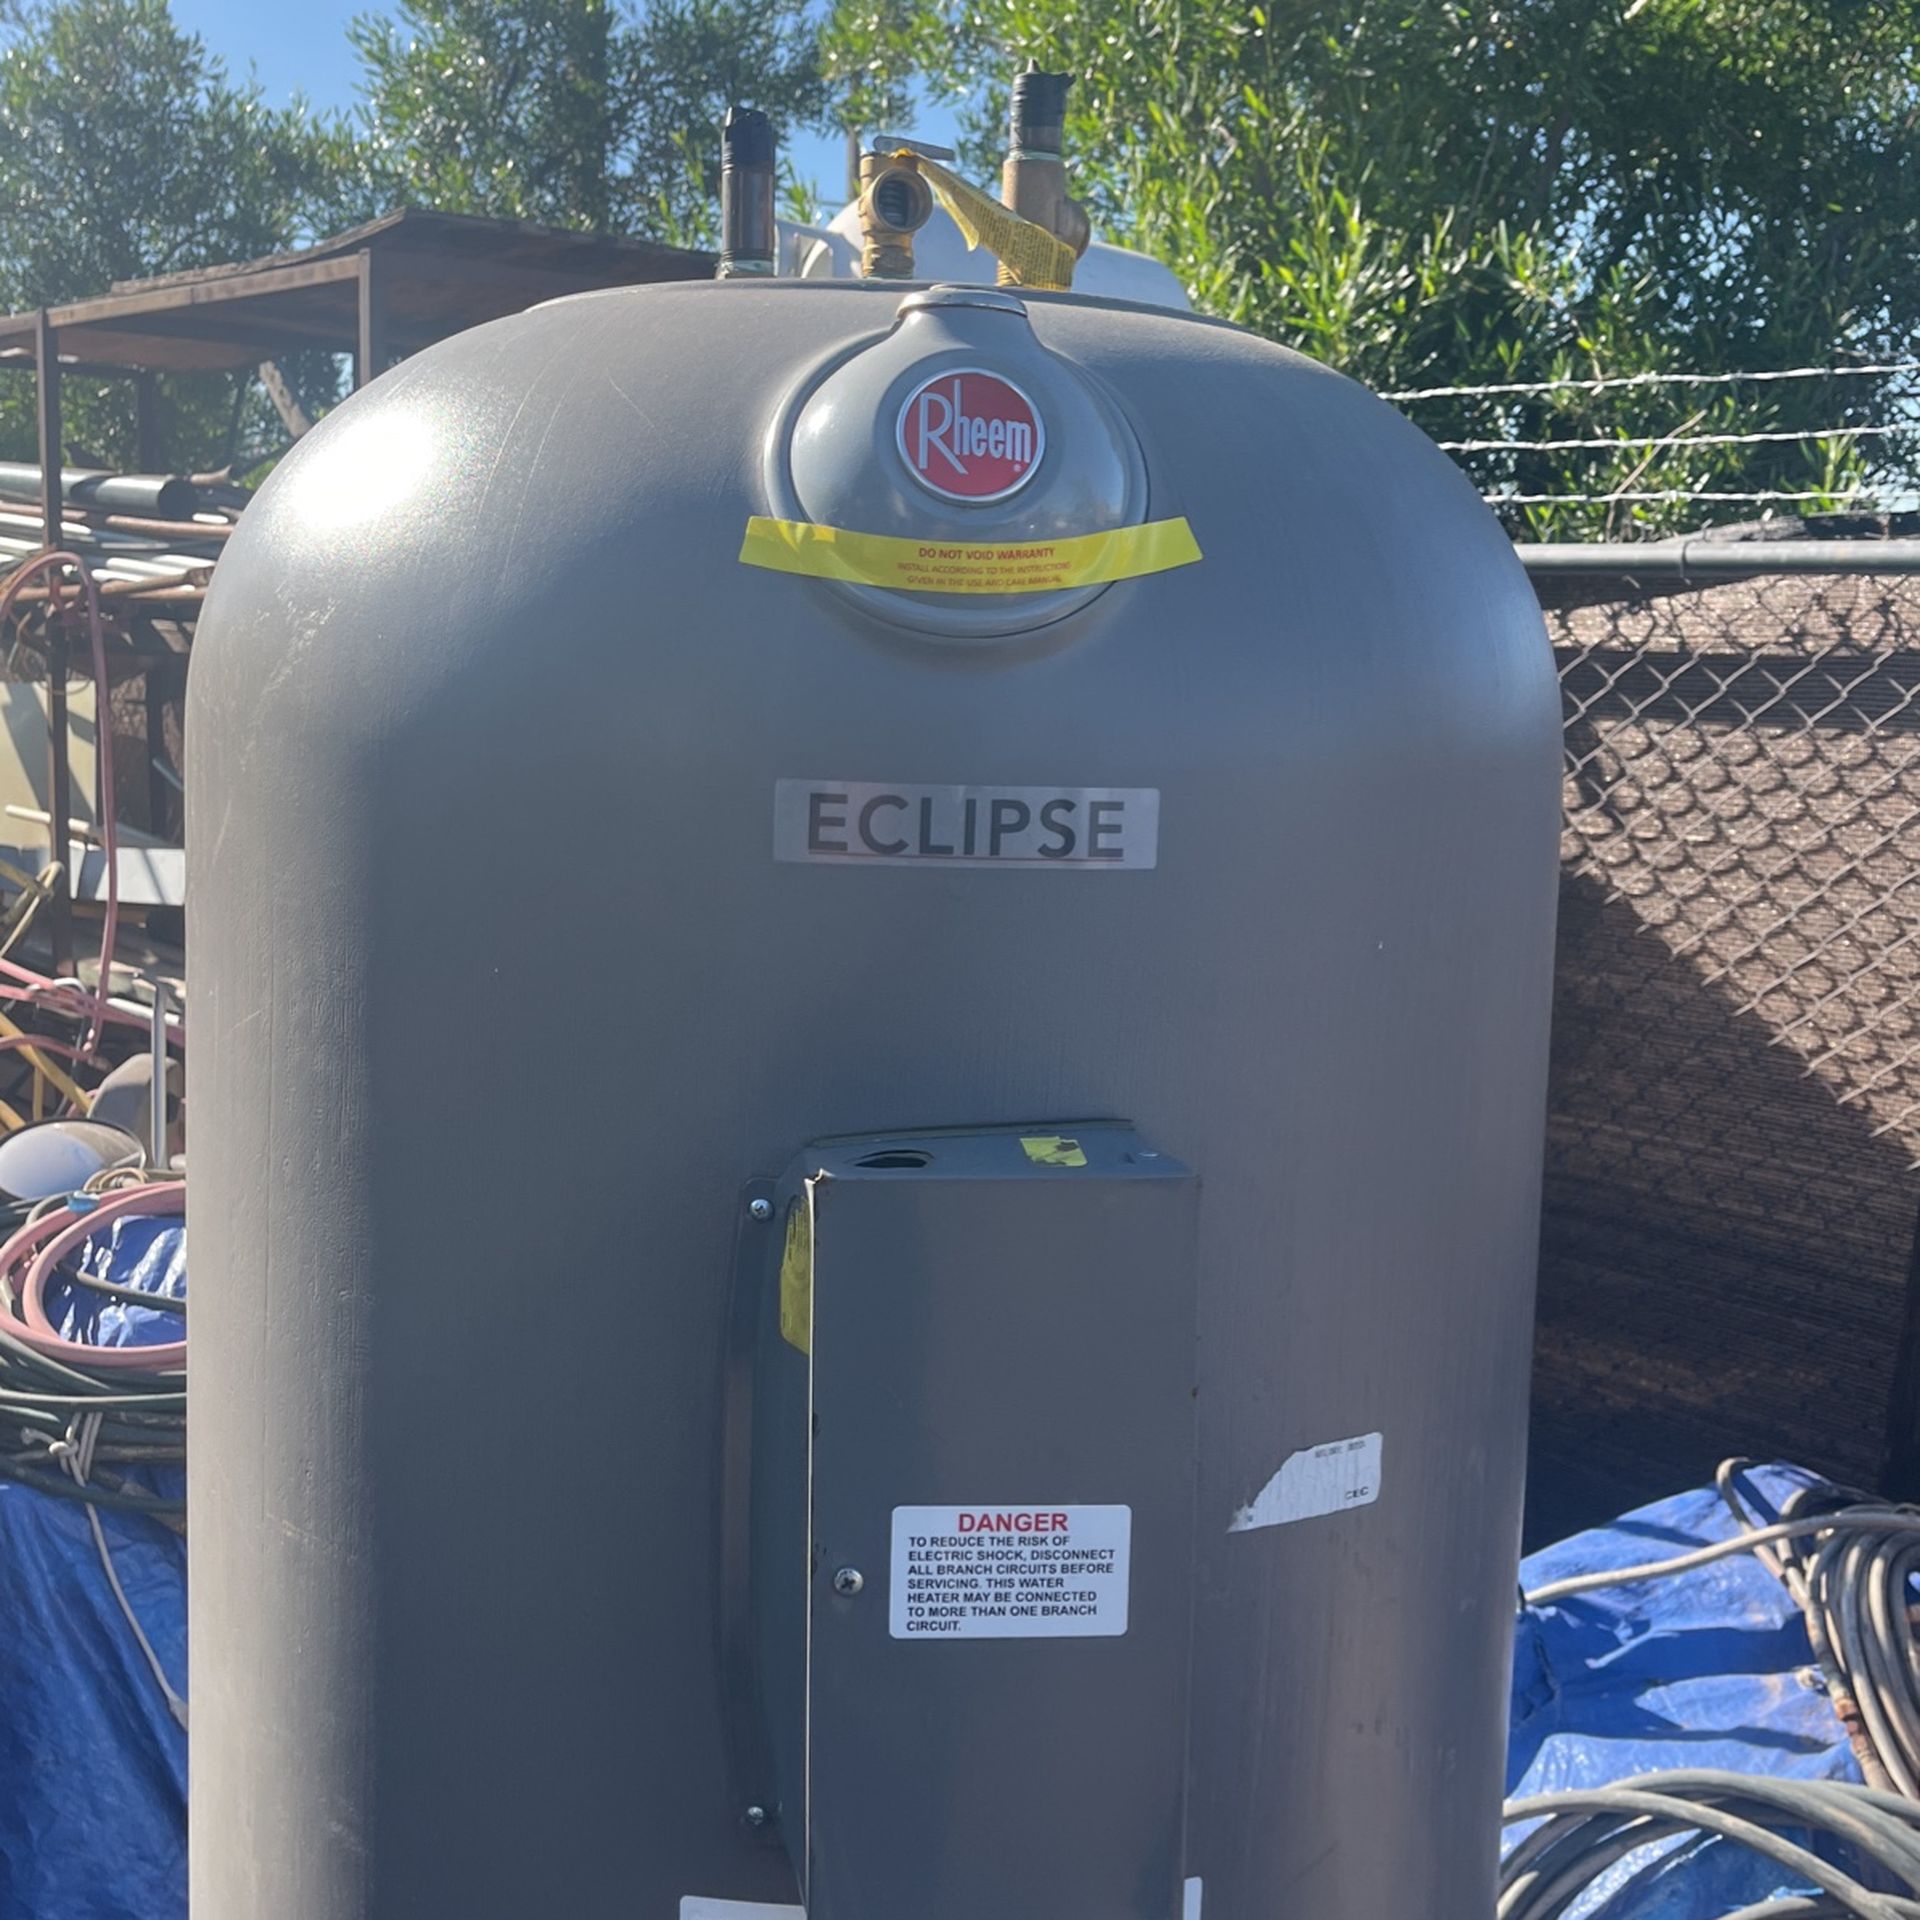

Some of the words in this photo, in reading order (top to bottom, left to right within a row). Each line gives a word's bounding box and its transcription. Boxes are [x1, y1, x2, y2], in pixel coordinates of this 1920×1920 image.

[918, 379, 1031, 475] Rheem
[919, 548, 936, 558] DO
[939, 549, 963, 559] NOT
[967, 550, 993, 560] VOID
[997, 547, 1055, 560] WARRANTY
[898, 562, 928, 572] INSTALL
[932, 565, 983, 574] ACCORDING
[1000, 566, 1015, 574] THE
[908, 576, 934, 585] GIVEN
[949, 578, 964, 586] THE
[967, 579, 984, 587] USE
[986, 578, 1003, 586] AND
[808, 792, 1125, 858] ECLIPSE
[958, 1513, 1068, 1532] DANGER
[909, 1537, 927, 1547] TO
[930, 1536, 984, 1547] REDUCE
[988, 1536, 1014, 1546] THE
[1018, 1536, 1049, 1546] RISK
[1052, 1536, 1070, 1546] OF
[908, 1551, 973, 1561] ELECTRIC
[977, 1550, 1027, 1562] SHOCK,
[1030, 1549, 1115, 1561] DISCONNECT
[908, 1564, 933, 1575] ALL
[936, 1564, 993, 1575] BRANCH
[996, 1564, 1057, 1575] CIRCUITS
[1060, 1563, 1114, 1574] BEFORE
[908, 1578, 982, 1589] SERVICING.
[986, 1578, 1015, 1588] THIS
[1019, 1578, 1064, 1588] WATER
[907, 1593, 959, 1603] HEATER
[963, 1593, 991, 1603] MAY
[994, 1592, 1012, 1602] BE
[1016, 1591, 1097, 1602] CONNECTED
[907, 1607, 925, 1617] TO
[929, 1606, 967, 1617] MORE
[971, 1606, 1006, 1616] THAN
[1010, 1606, 1038, 1616] ONE
[1041, 1605, 1097, 1616] BRANCH
[907, 1621, 961, 1632] CIRCUIT.
